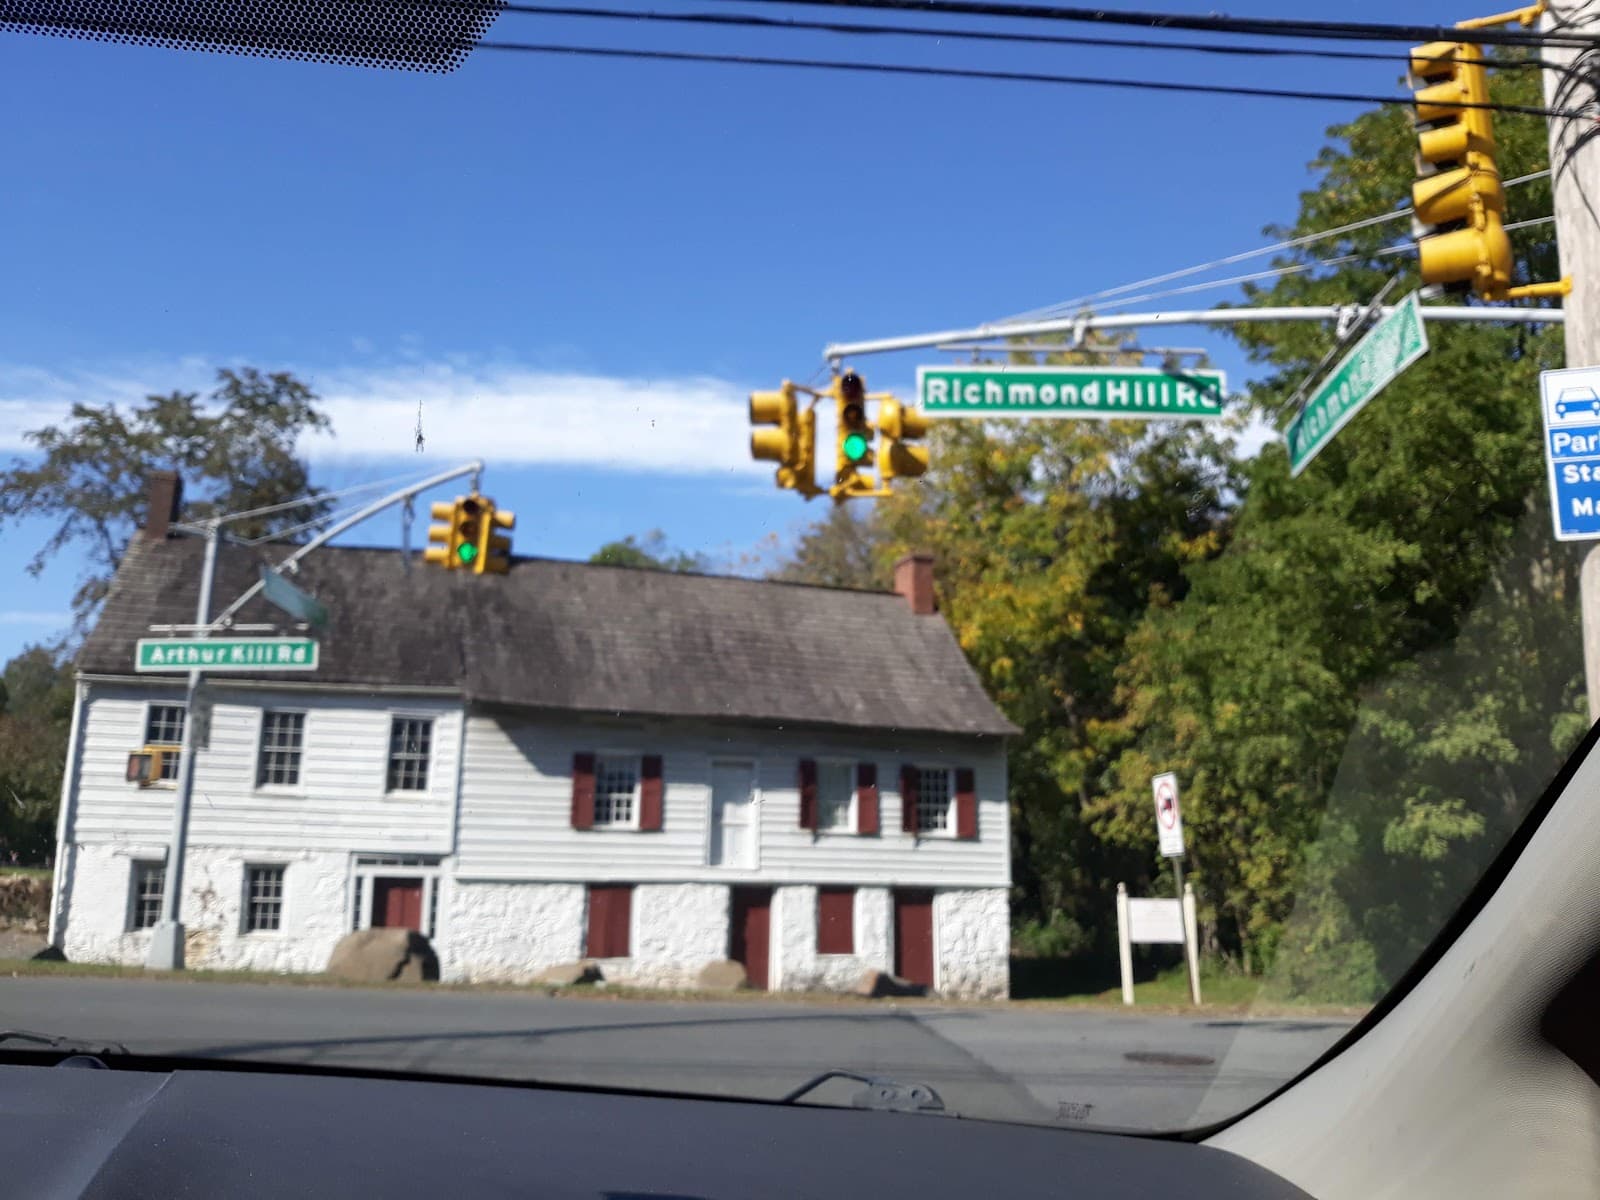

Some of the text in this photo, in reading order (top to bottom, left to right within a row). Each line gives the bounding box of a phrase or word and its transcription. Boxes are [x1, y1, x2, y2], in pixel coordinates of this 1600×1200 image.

[926, 377, 1100, 406] Richmond
[1106, 379, 1169, 407] Hill
[1552, 430, 1600, 454] Par
[1571, 496, 1600, 517] M
[150, 645, 307, 664] Arthur Kill Rd
